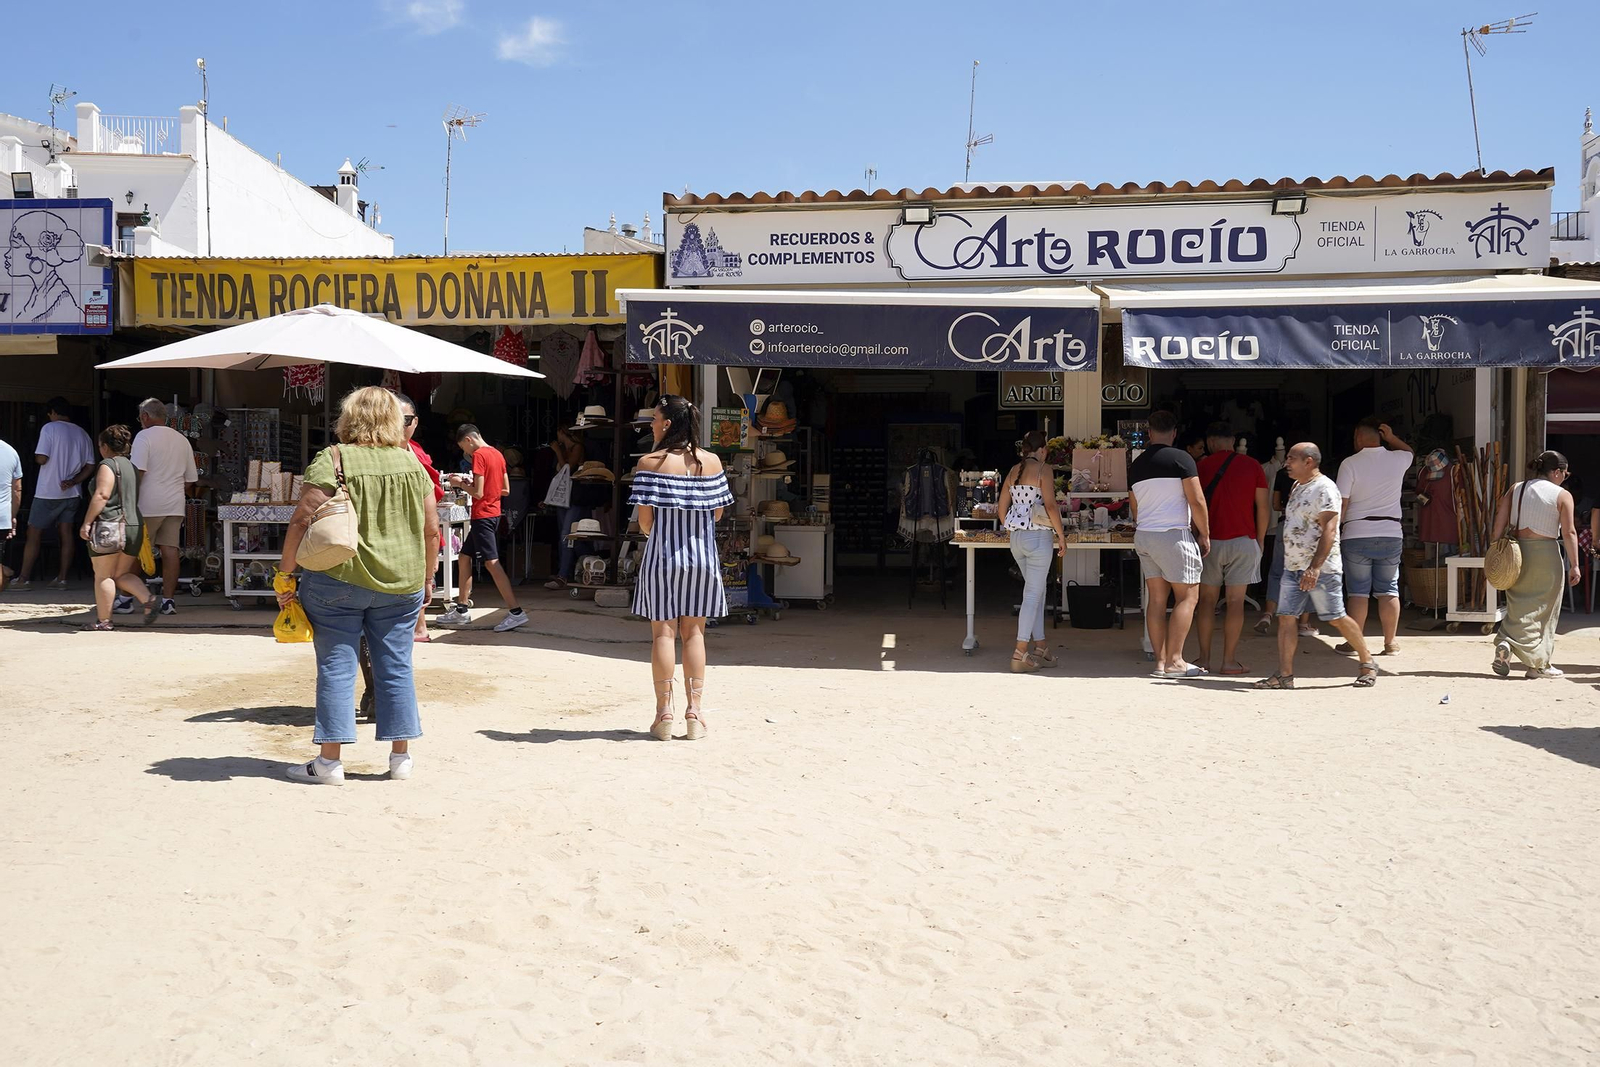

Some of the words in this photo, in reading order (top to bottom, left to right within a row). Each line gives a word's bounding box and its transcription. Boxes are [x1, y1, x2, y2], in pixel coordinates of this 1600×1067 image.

[1319, 220, 1366, 232] TIENDA
[769, 231, 861, 246] RECUERDOS
[864, 231, 875, 245] &
[914, 213, 1074, 274] Arte
[1087, 218, 1268, 270] ROCÍO
[1316, 236, 1366, 248] OFICIAL
[747, 250, 875, 266] COMPLEMENTOS
[1384, 248, 1398, 257] LA
[1401, 247, 1456, 256] GARROCHA
[150, 272, 259, 320] TIENDA
[416, 262, 550, 319] DOÑANA
[570, 269, 610, 318] II
[768, 321, 824, 335] arterocio_
[1333, 324, 1380, 336] TIENDA
[947, 312, 1088, 370] Arte
[1131, 330, 1260, 363] ROCÍO
[1331, 339, 1380, 351] OFICIAL
[767, 342, 909, 357] infoarterocio@gmail.com
[1399, 352, 1413, 360] LA
[1416, 351, 1472, 360] GARROCHA
[1005, 385, 1064, 402] ARTE
[1101, 378, 1145, 402] CÍO
